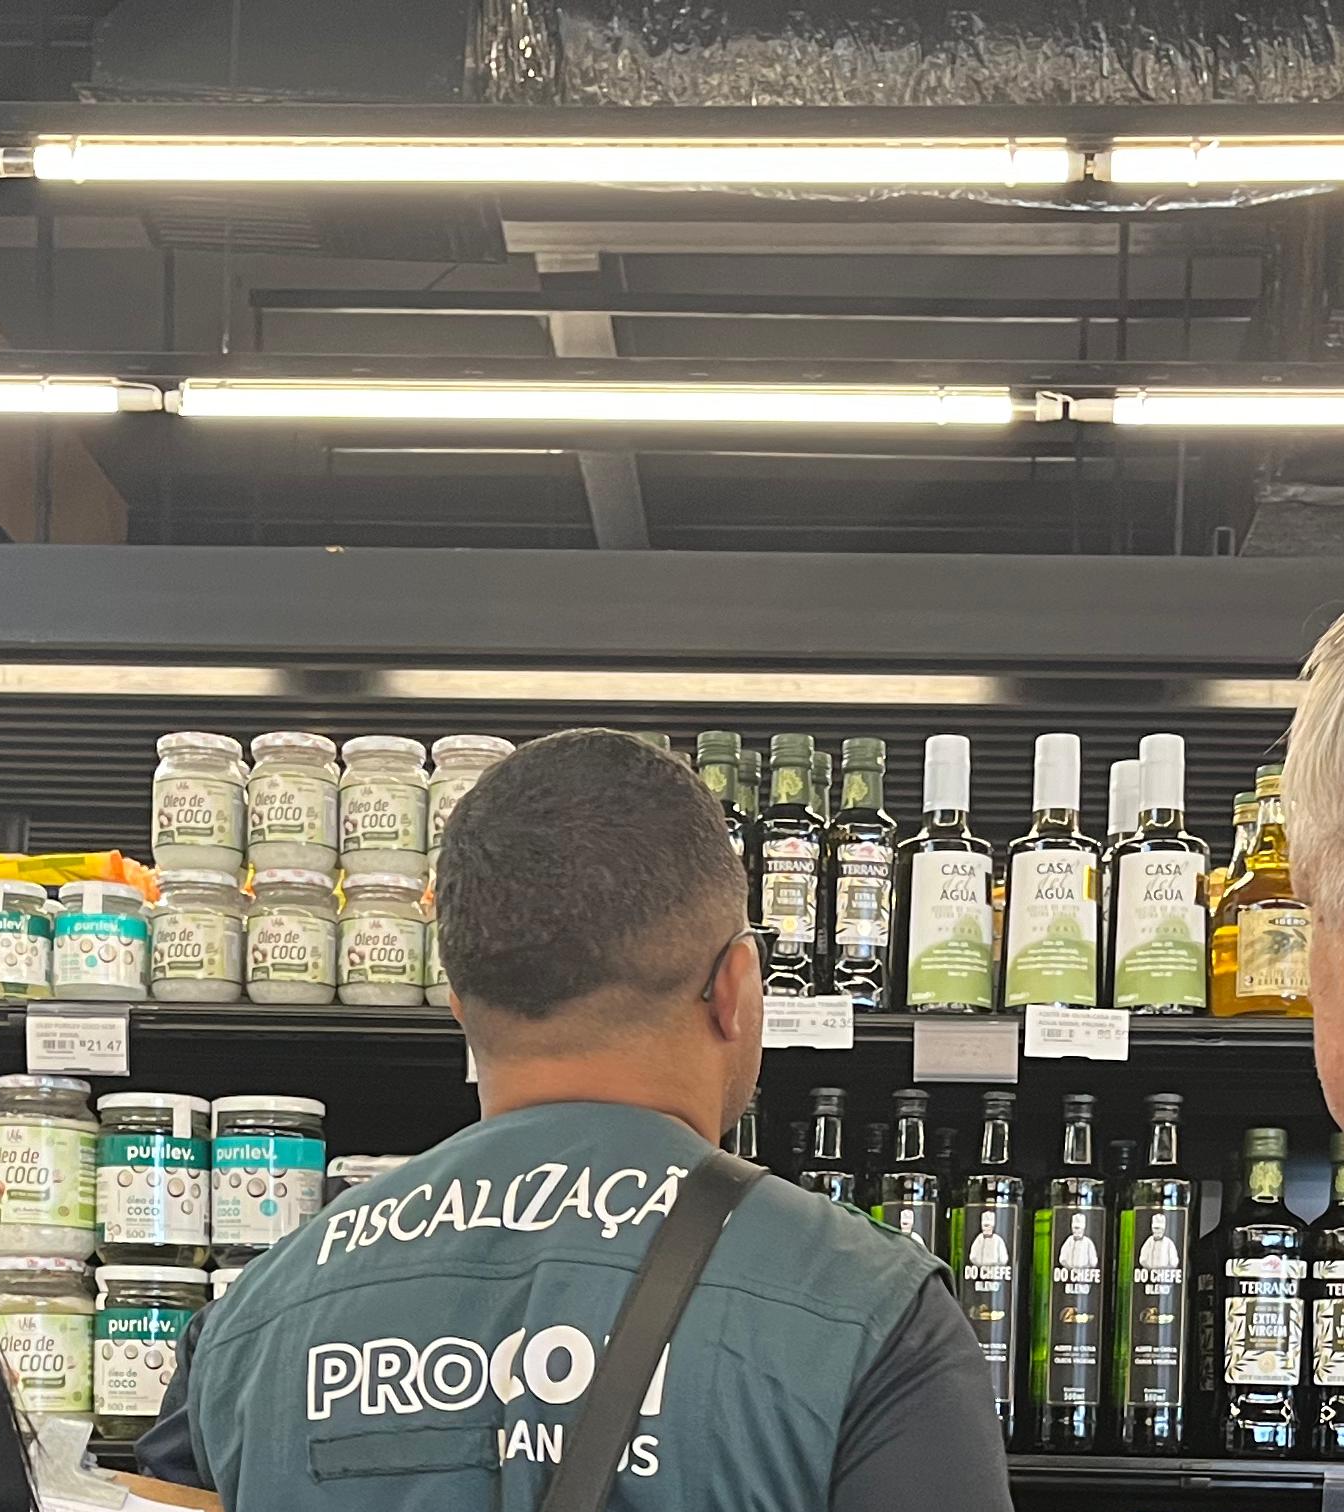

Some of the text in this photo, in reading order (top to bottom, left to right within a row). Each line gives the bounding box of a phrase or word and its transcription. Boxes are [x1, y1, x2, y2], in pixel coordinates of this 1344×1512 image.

[439, 795, 457, 809] Óle
[941, 864, 975, 877] CASA
[1037, 863, 1073, 874] CASA
[1145, 864, 1181, 876] CASA
[940, 889, 977, 901] AGUA
[1035, 888, 1074, 900] AGUA
[1144, 890, 1183, 901] AGUA
[316, 1163, 732, 1267] FISCALIZAÇÃ
[964, 1265, 1012, 1281] DO CHEFE
[1054, 1268, 1101, 1284] DO CHEFE
[1134, 1268, 1182, 1284] DO CHEFE
[1252, 1313, 1284, 1325] EXTRA
[1248, 1325, 1287, 1338] VIRGEM
